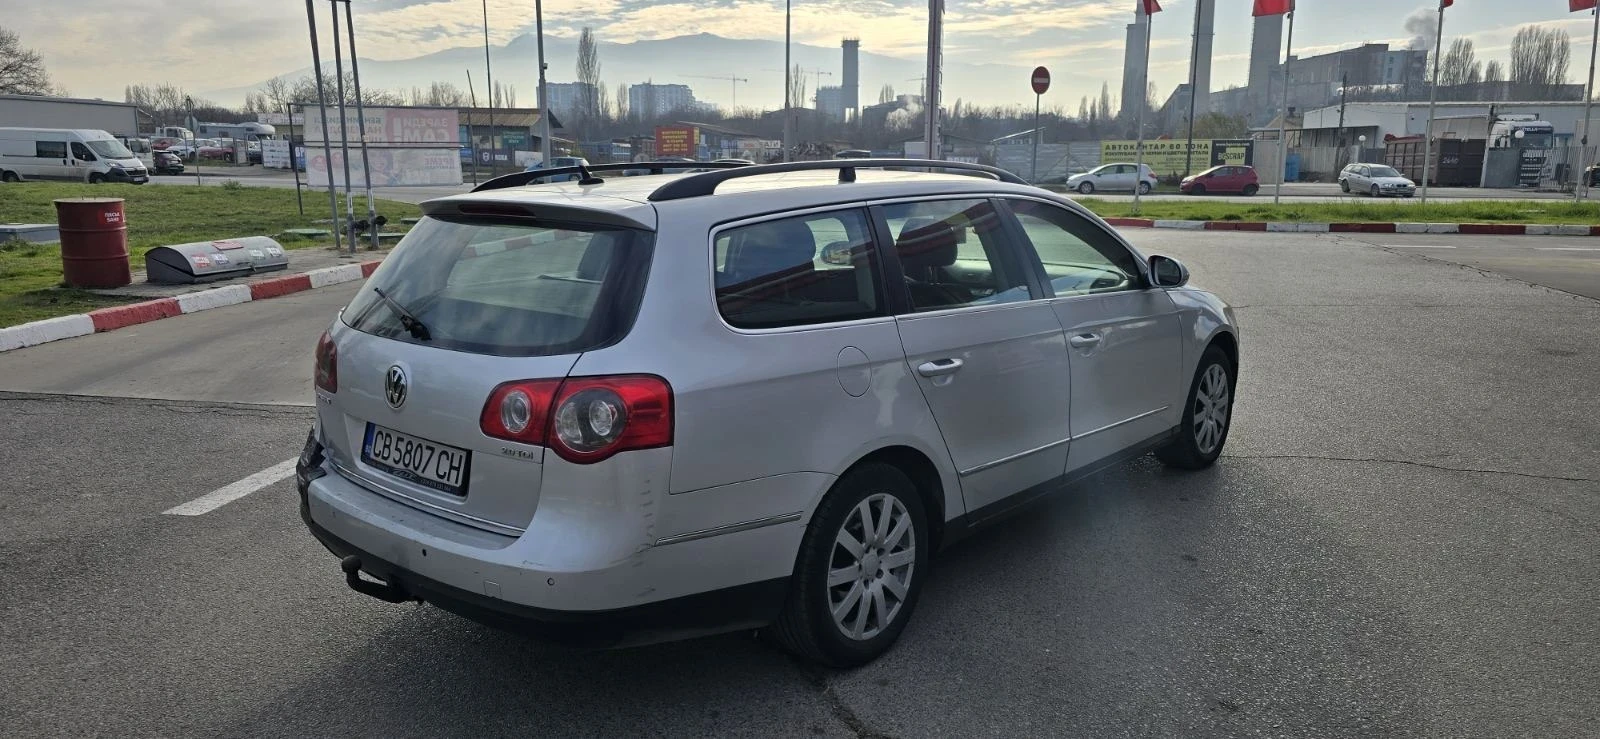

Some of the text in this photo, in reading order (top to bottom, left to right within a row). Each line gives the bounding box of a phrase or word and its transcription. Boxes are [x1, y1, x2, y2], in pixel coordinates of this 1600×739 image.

[373, 430, 463, 484] CB 5807 CH
